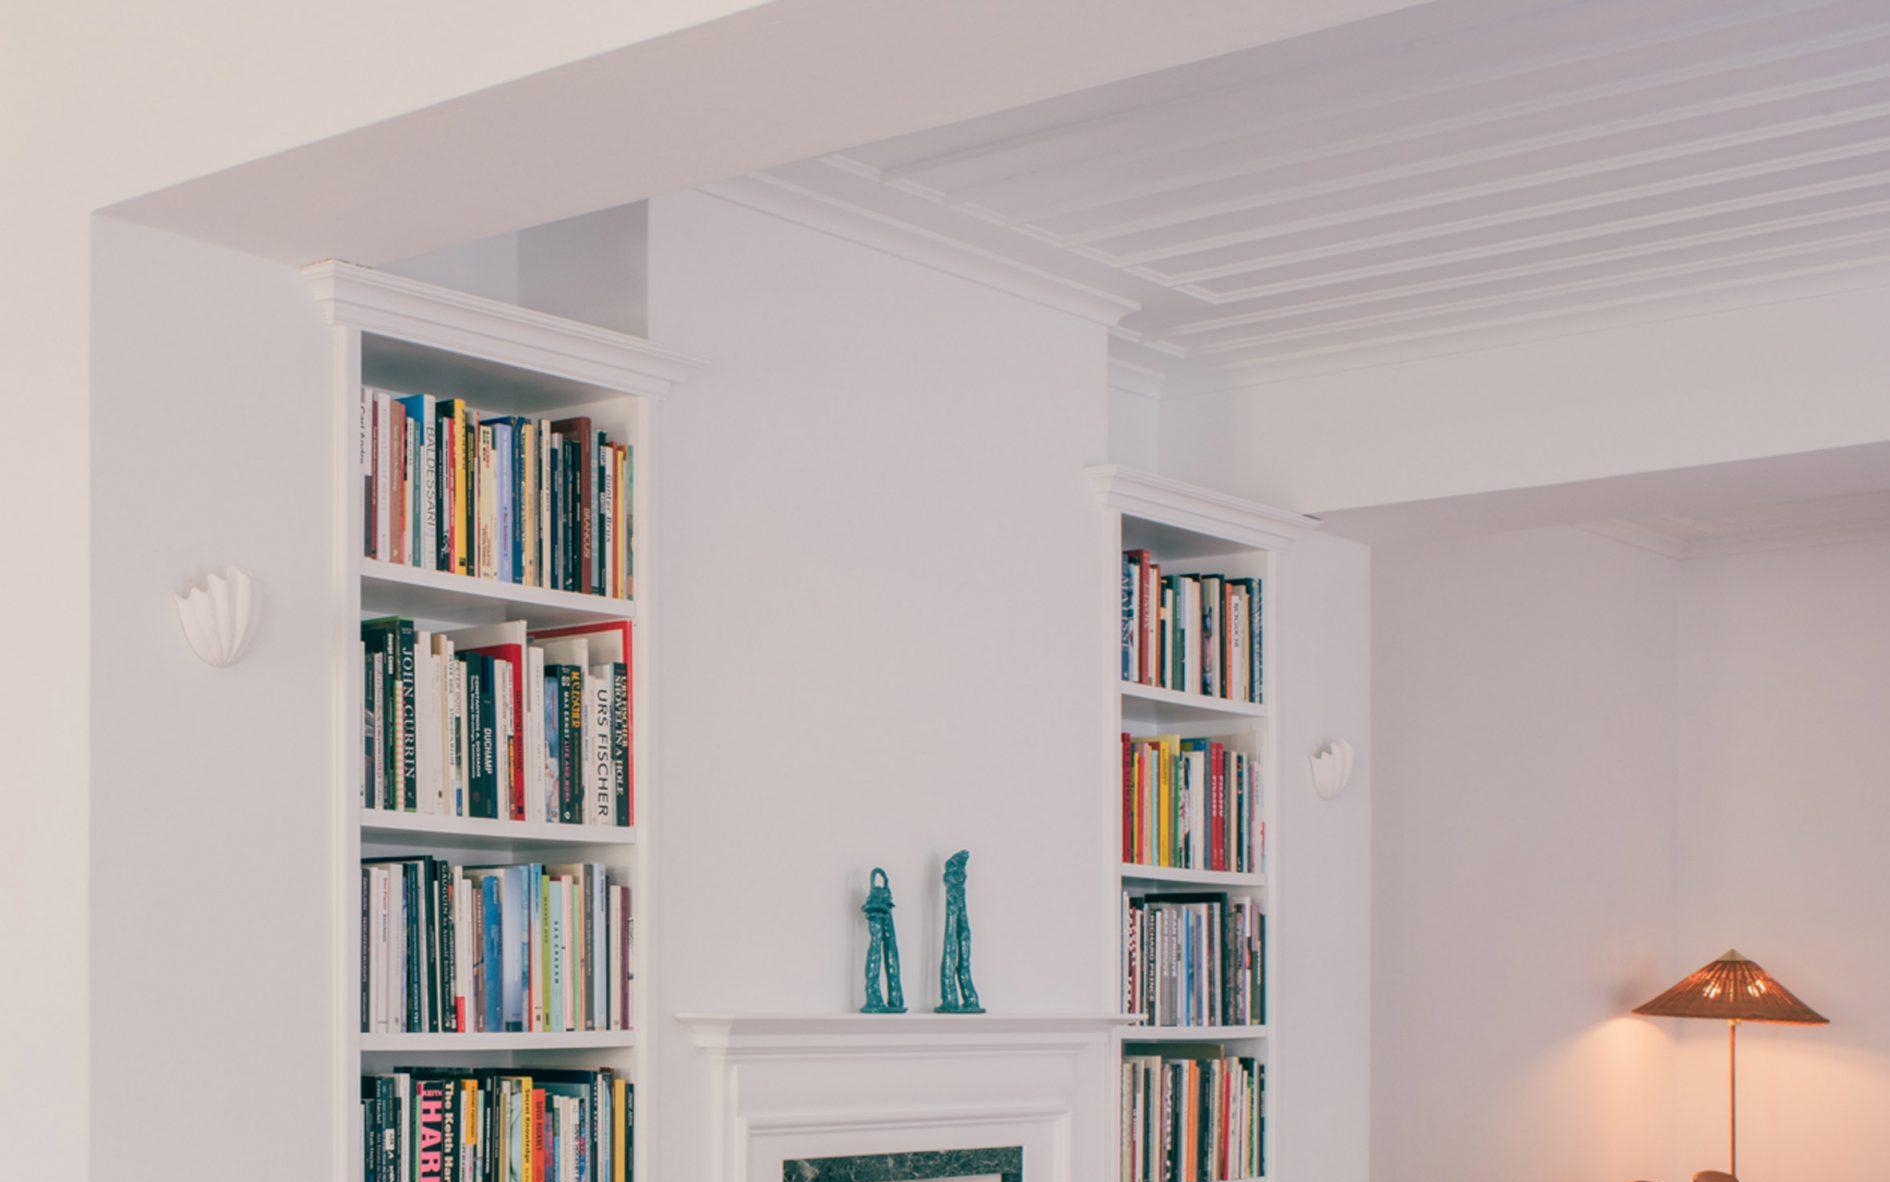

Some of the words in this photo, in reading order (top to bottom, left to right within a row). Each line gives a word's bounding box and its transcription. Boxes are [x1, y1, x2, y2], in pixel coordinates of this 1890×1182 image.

[426, 427, 435, 526] BALDESSARI
[402, 648, 414, 696] JOHN
[597, 690, 608, 726] URS
[614, 675, 622, 728] SHOVEL
[404, 705, 415, 779] CURRIN
[484, 728, 492, 774] DUCHAMP
[615, 730, 622, 742] IN
[615, 744, 622, 756] A
[598, 734, 608, 816] FISCHER
[444, 1082, 454, 1110] The
[444, 1113, 454, 1152] Keith
